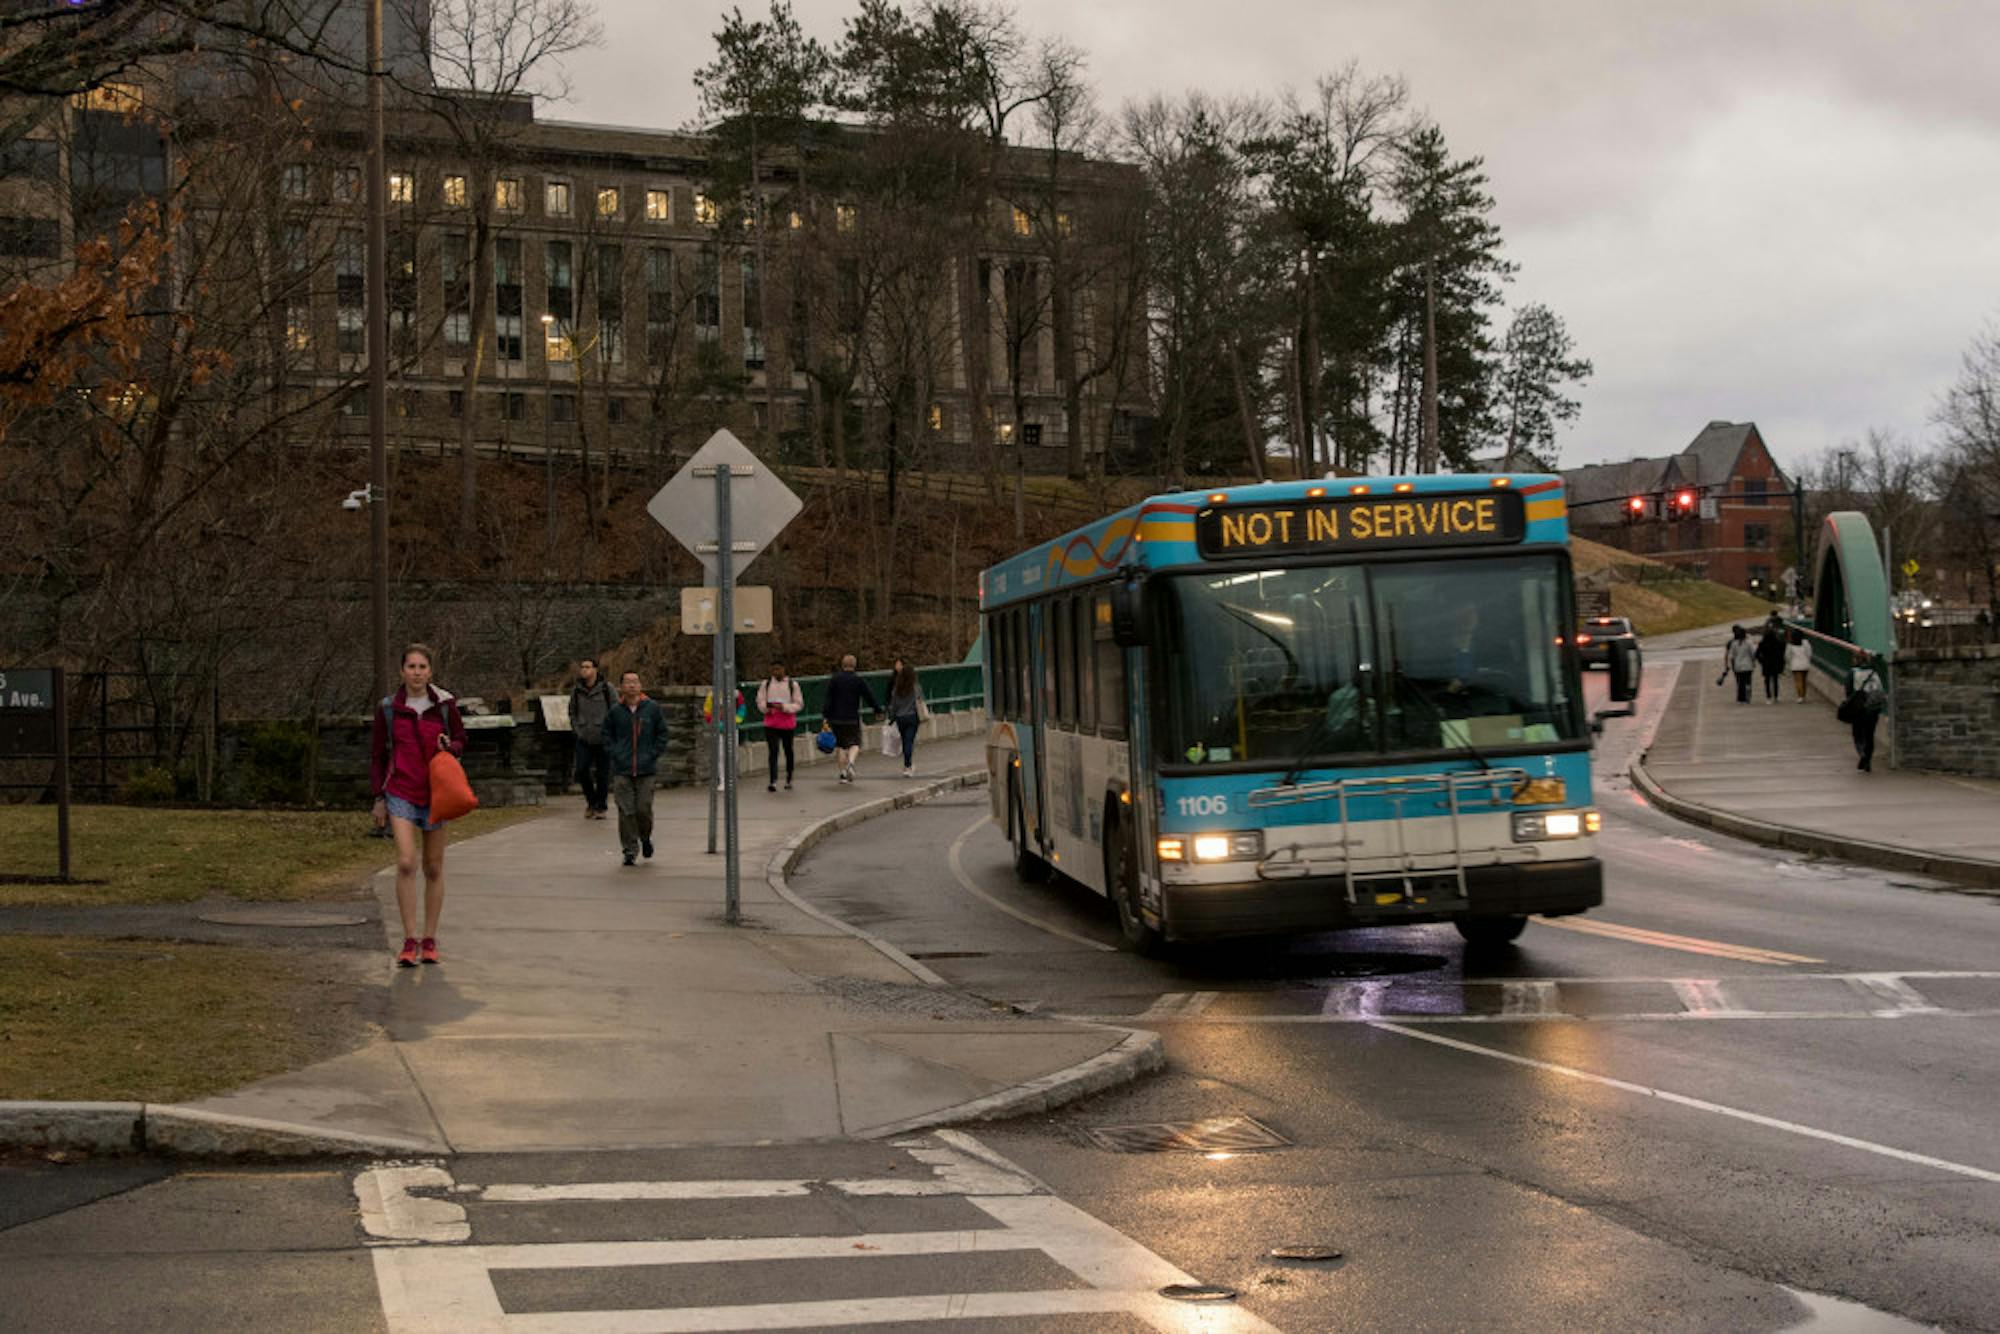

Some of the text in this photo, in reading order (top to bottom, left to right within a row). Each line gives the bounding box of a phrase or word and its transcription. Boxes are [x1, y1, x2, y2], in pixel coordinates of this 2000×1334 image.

[1220, 498, 1496, 547] NOT IN SERVICE
[10, 691, 44, 707] Ave.
[1177, 795, 1228, 816] 1106
